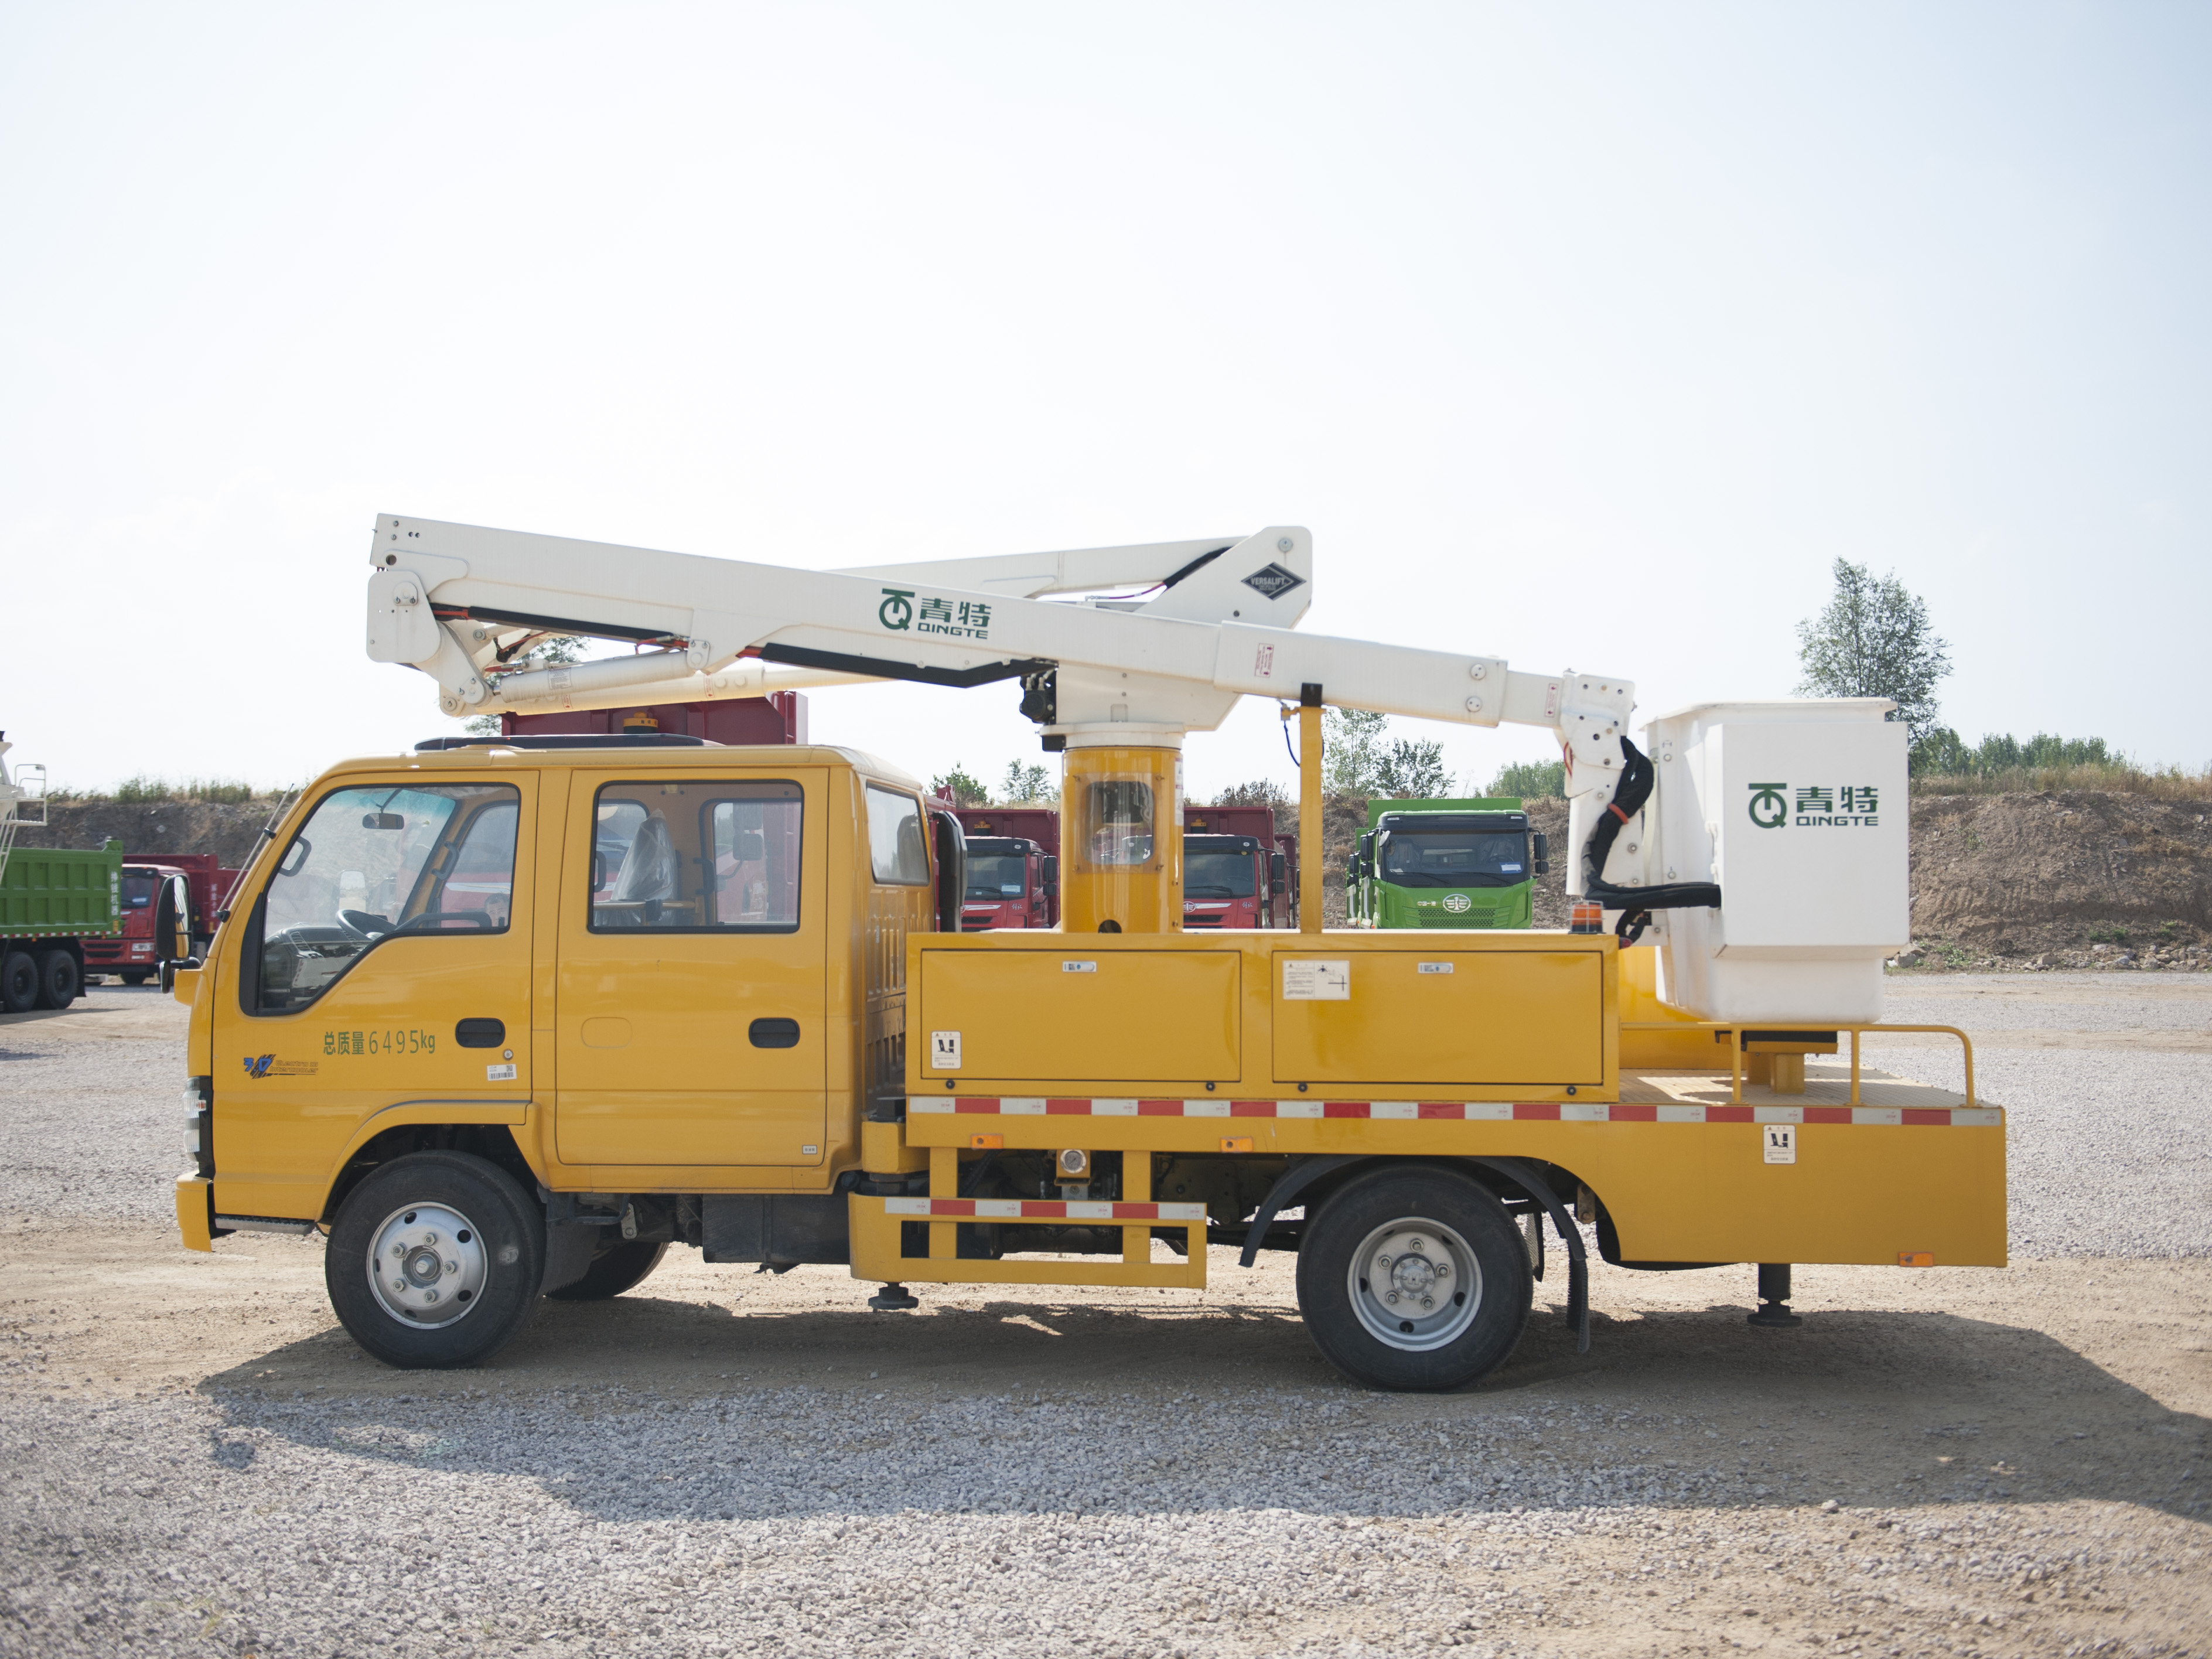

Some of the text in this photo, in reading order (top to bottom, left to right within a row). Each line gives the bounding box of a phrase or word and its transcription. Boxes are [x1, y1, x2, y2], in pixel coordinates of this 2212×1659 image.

[1251, 577, 1285, 585] VERSALIFT
[919, 598, 992, 627] 青特
[917, 622, 988, 640] QINGTE
[1796, 787, 1878, 813] 青特
[1796, 816, 1879, 826] QINGTE
